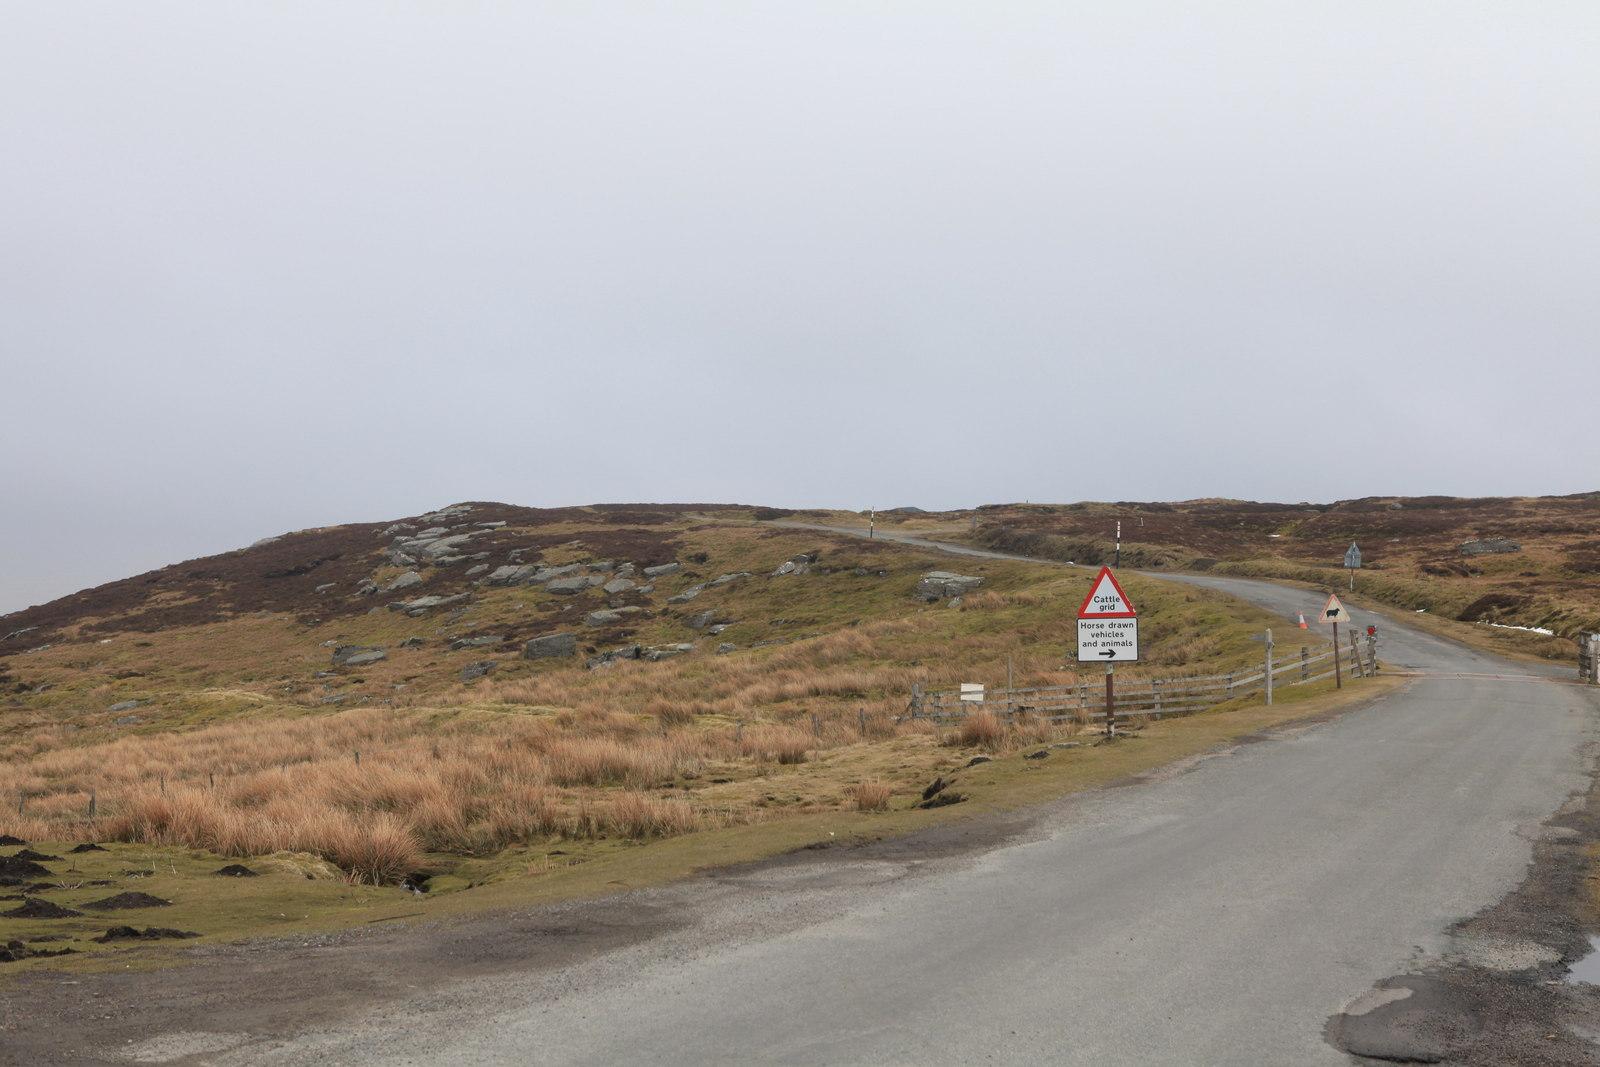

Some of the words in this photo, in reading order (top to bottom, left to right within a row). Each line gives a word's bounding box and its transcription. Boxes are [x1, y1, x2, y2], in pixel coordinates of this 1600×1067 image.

[1093, 595, 1120, 603] Cattle
[1099, 603, 1115, 612] grid
[1108, 621, 1134, 629] drawn
[1101, 639, 1133, 647] animals
